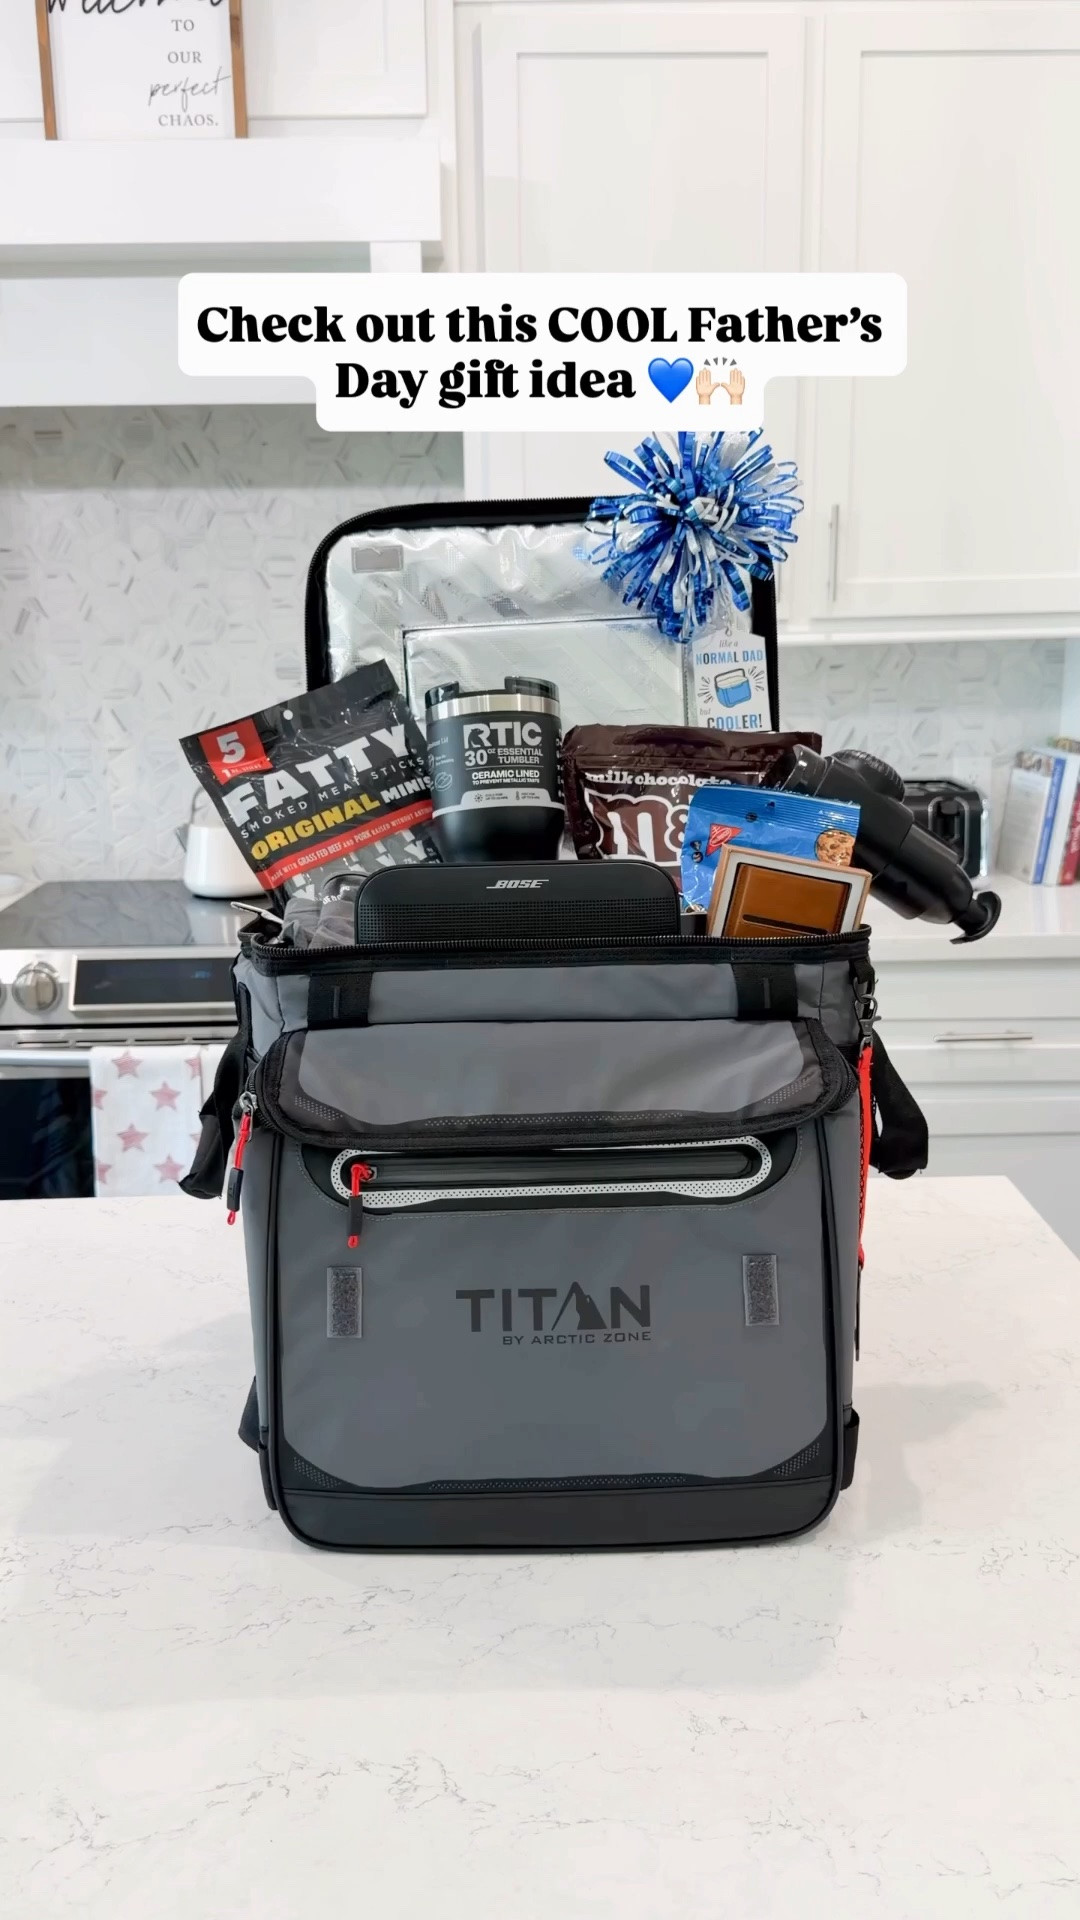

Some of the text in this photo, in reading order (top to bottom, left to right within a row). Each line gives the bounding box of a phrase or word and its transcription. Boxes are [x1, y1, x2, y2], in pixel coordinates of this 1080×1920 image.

[171, 19, 195, 32] TO
[167, 51, 202, 64] OUR
[148, 66, 231, 112] perfect
[158, 114, 219, 127] CHAOS.
[696, 650, 764, 665] NORMAL DAD
[707, 713, 763, 730] COOLER!
[463, 722, 542, 749] RTIC
[217, 731, 246, 763] 5
[464, 749, 488, 767] 30
[497, 748, 543, 757] ESSENTIAL
[498, 756, 540, 765] TUMBLER
[222, 724, 410, 827] FATTY
[472, 769, 540, 780] CERAMIC LINED
[585, 770, 633, 784] milk
[241, 801, 308, 839] SMOKED
[318, 777, 360, 801] MEAT
[371, 757, 424, 780] STICKS
[250, 776, 434, 861] ORIGINAL MINIS
[297, 853, 317, 866] GRASS
[316, 847, 329, 858] FED
[328, 842, 342, 853] BEEF
[343, 839, 354, 848] AND
[354, 830, 371, 843] PORK
[371, 824, 391, 837] RAISED
[391, 813, 414, 827] WITHOUT
[486, 879, 549, 889] BOSE
[456, 1281, 650, 1332] TITAN
[502, 1331, 651, 1345] BY ARCTIC ZONE
